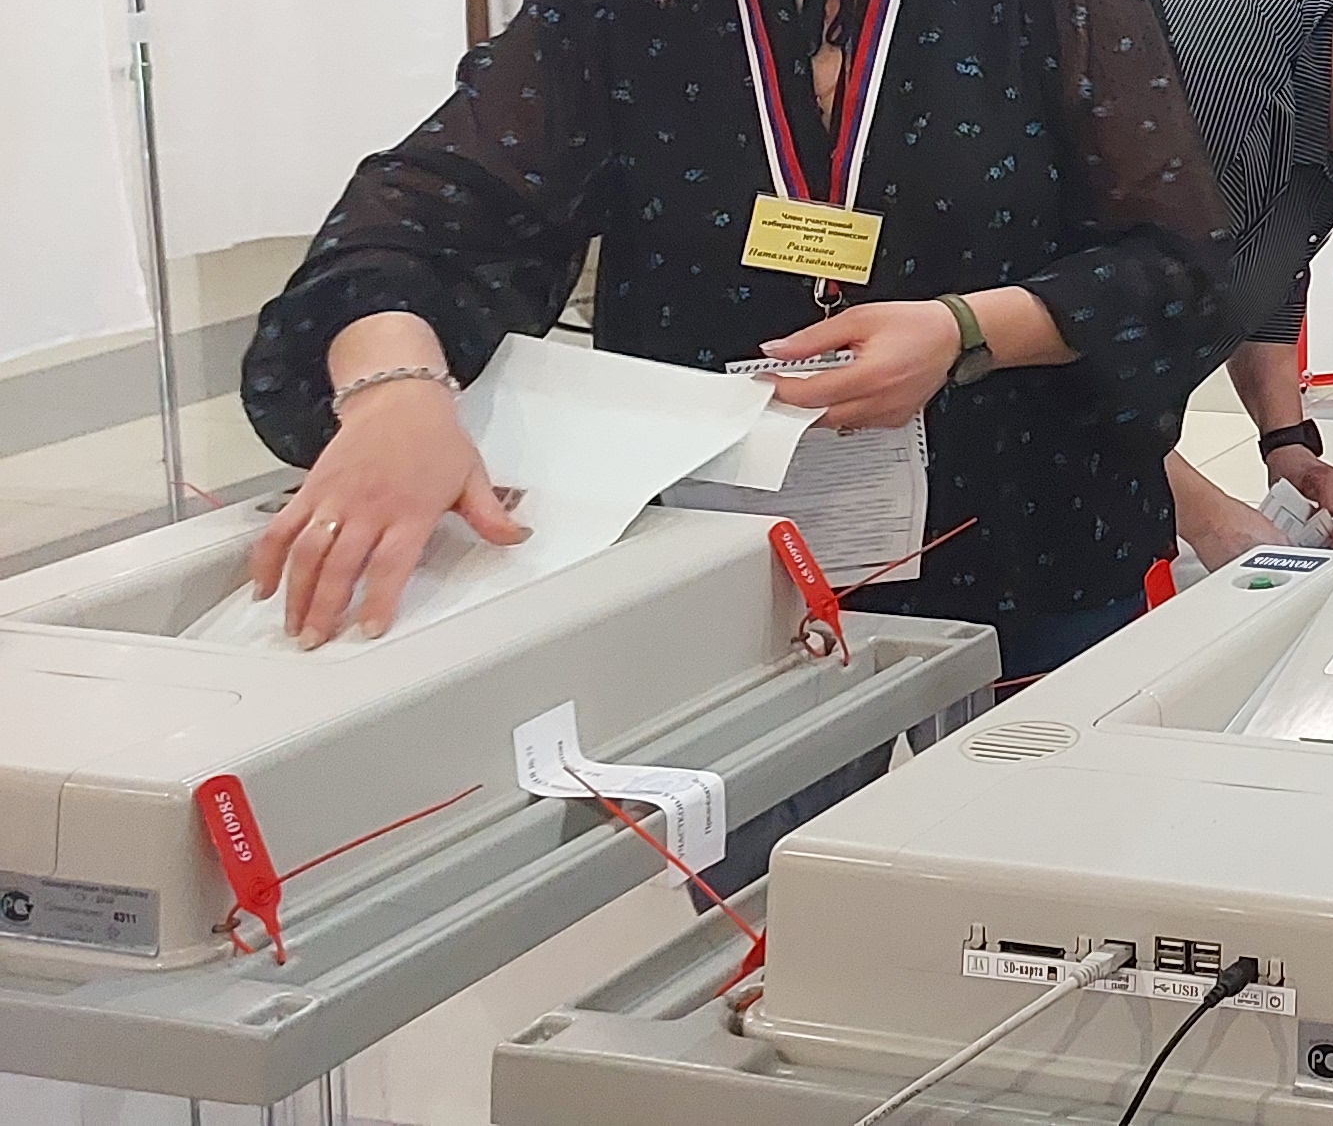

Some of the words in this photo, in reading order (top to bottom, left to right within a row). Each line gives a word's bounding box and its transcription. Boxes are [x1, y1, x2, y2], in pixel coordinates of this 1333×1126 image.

[215, 790, 253, 862] 6510985
[1004, 962, 1044, 979] SD-карта
[1172, 986, 1199, 997] USB
